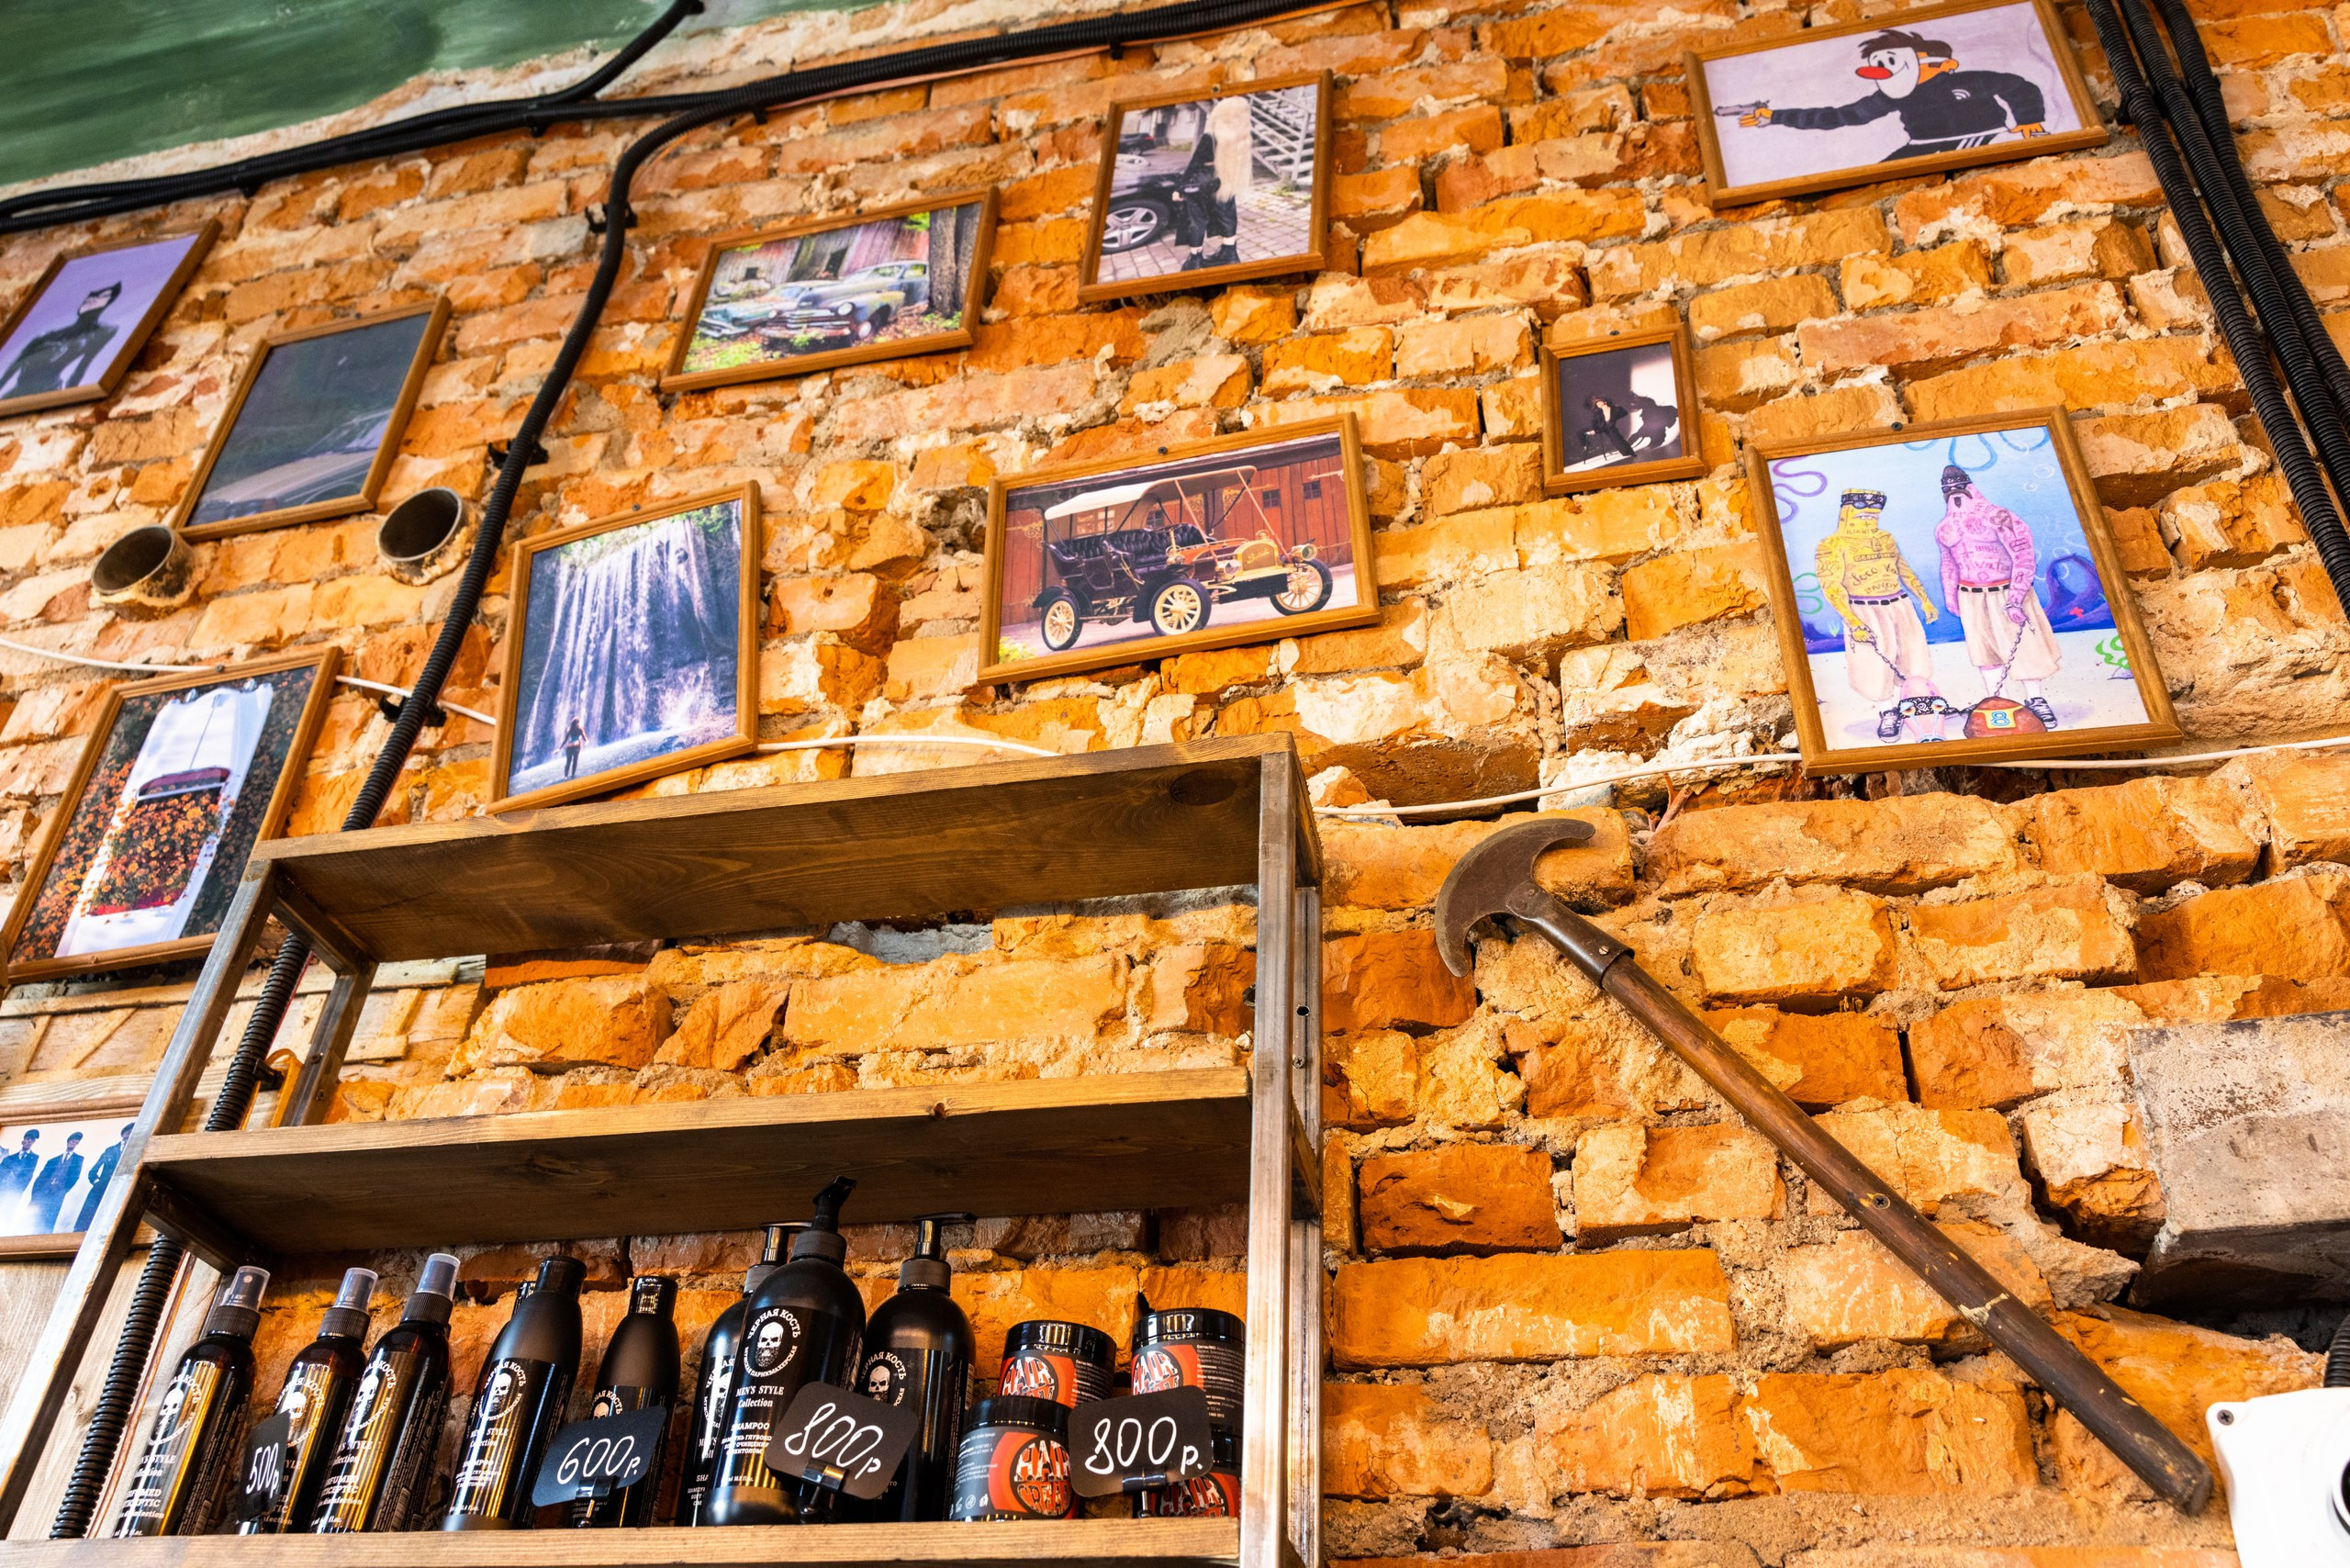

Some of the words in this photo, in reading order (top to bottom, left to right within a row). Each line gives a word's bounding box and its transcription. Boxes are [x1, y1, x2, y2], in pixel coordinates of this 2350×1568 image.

[1990, 711, 2010, 726] 8
[747, 1308, 779, 1339] ЧЕРНАЯ
[779, 1309, 801, 1338] КОСТЬ
[509, 1361, 526, 1387] КОСТЬ
[885, 1351, 907, 1381] КОСТЬ
[1002, 1357, 1055, 1395] HAIR
[606, 1390, 623, 1415] КОСТЬ
[735, 1385, 756, 1397] MEN'S
[758, 1385, 784, 1395] STYLE
[737, 1397, 773, 1408] Collection
